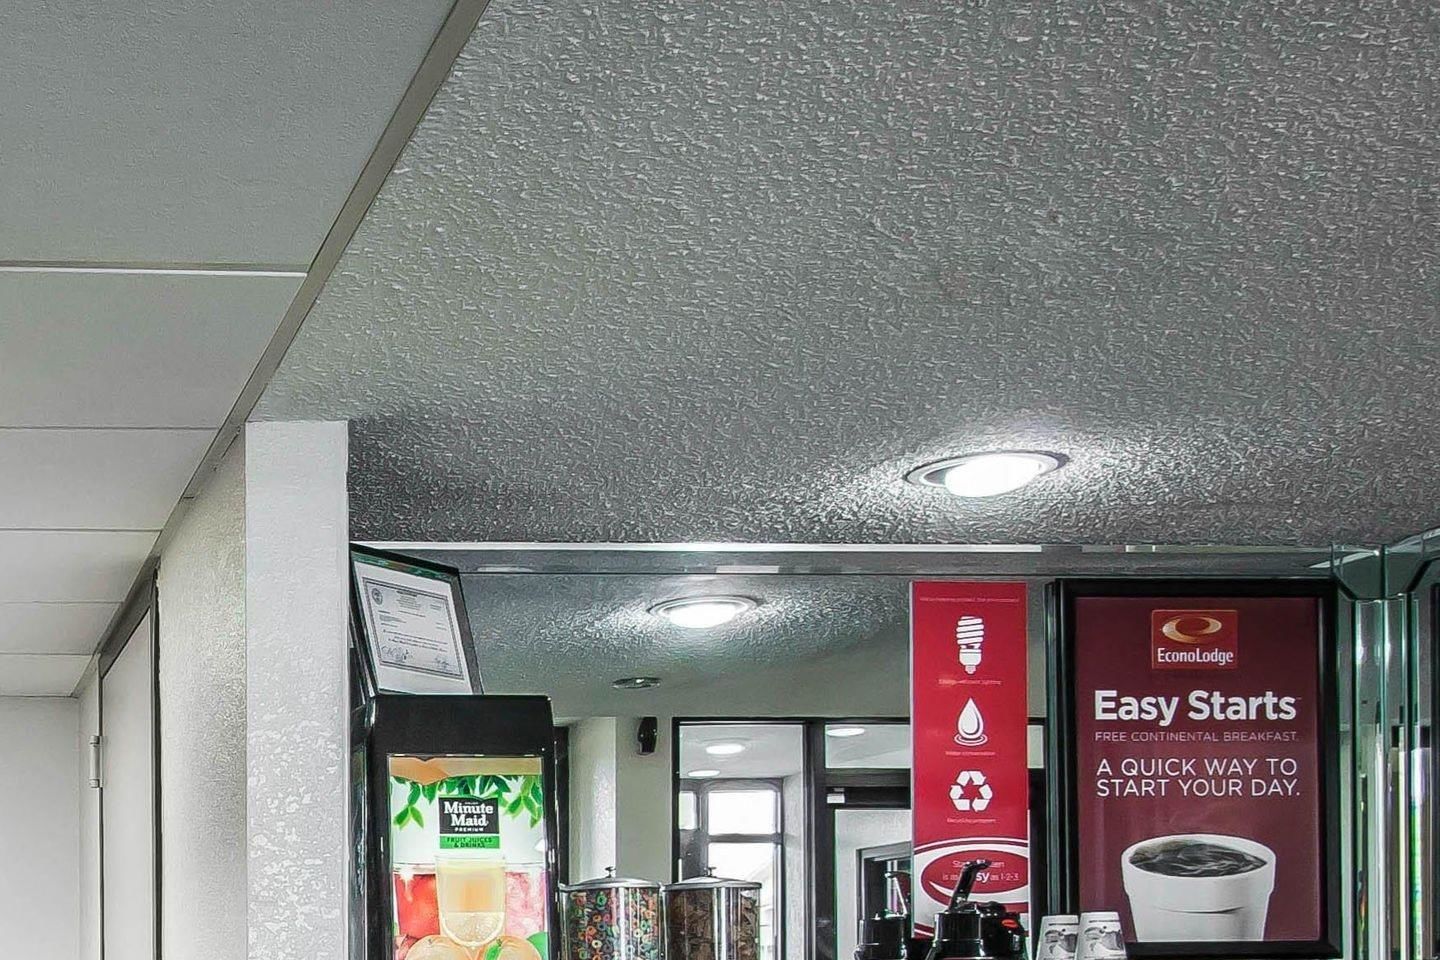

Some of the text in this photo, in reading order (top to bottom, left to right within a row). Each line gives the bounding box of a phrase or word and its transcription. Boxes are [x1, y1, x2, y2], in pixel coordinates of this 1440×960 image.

[1157, 647, 1234, 666] EconoLodge
[1094, 690, 1297, 727] Easy Starts
[1095, 731, 1127, 742] FREE
[1131, 731, 1219, 742] CONTINENTAL
[1096, 758, 1298, 776] A QUICK WAY TO
[1096, 778, 1300, 797] START YOUR DAY.
[443, 801, 494, 814] Minute
[450, 813, 488, 827] Maid
